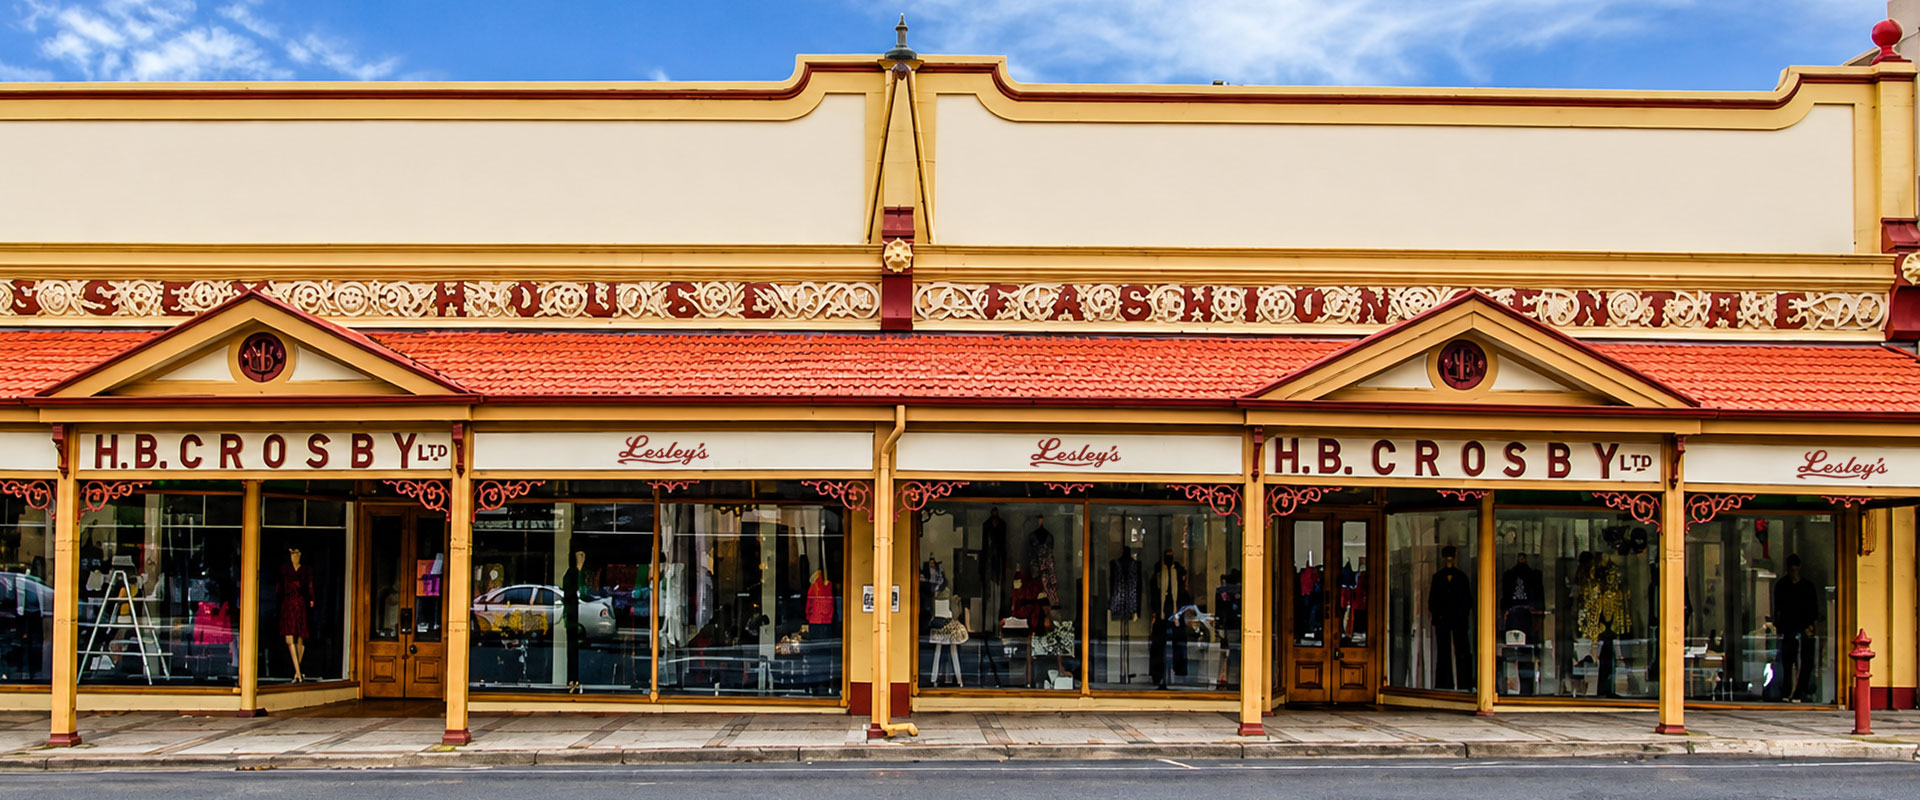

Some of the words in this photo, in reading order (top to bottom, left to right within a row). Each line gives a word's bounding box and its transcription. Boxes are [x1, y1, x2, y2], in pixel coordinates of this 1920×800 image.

[179, 432, 418, 469] CROSBY
[617, 435, 710, 466] Lesley's
[1030, 437, 1122, 468] Lesley's
[1275, 437, 1353, 475] H.B.
[1371, 439, 1620, 479] CROSBY
[1796, 449, 1889, 480] Lesley's
